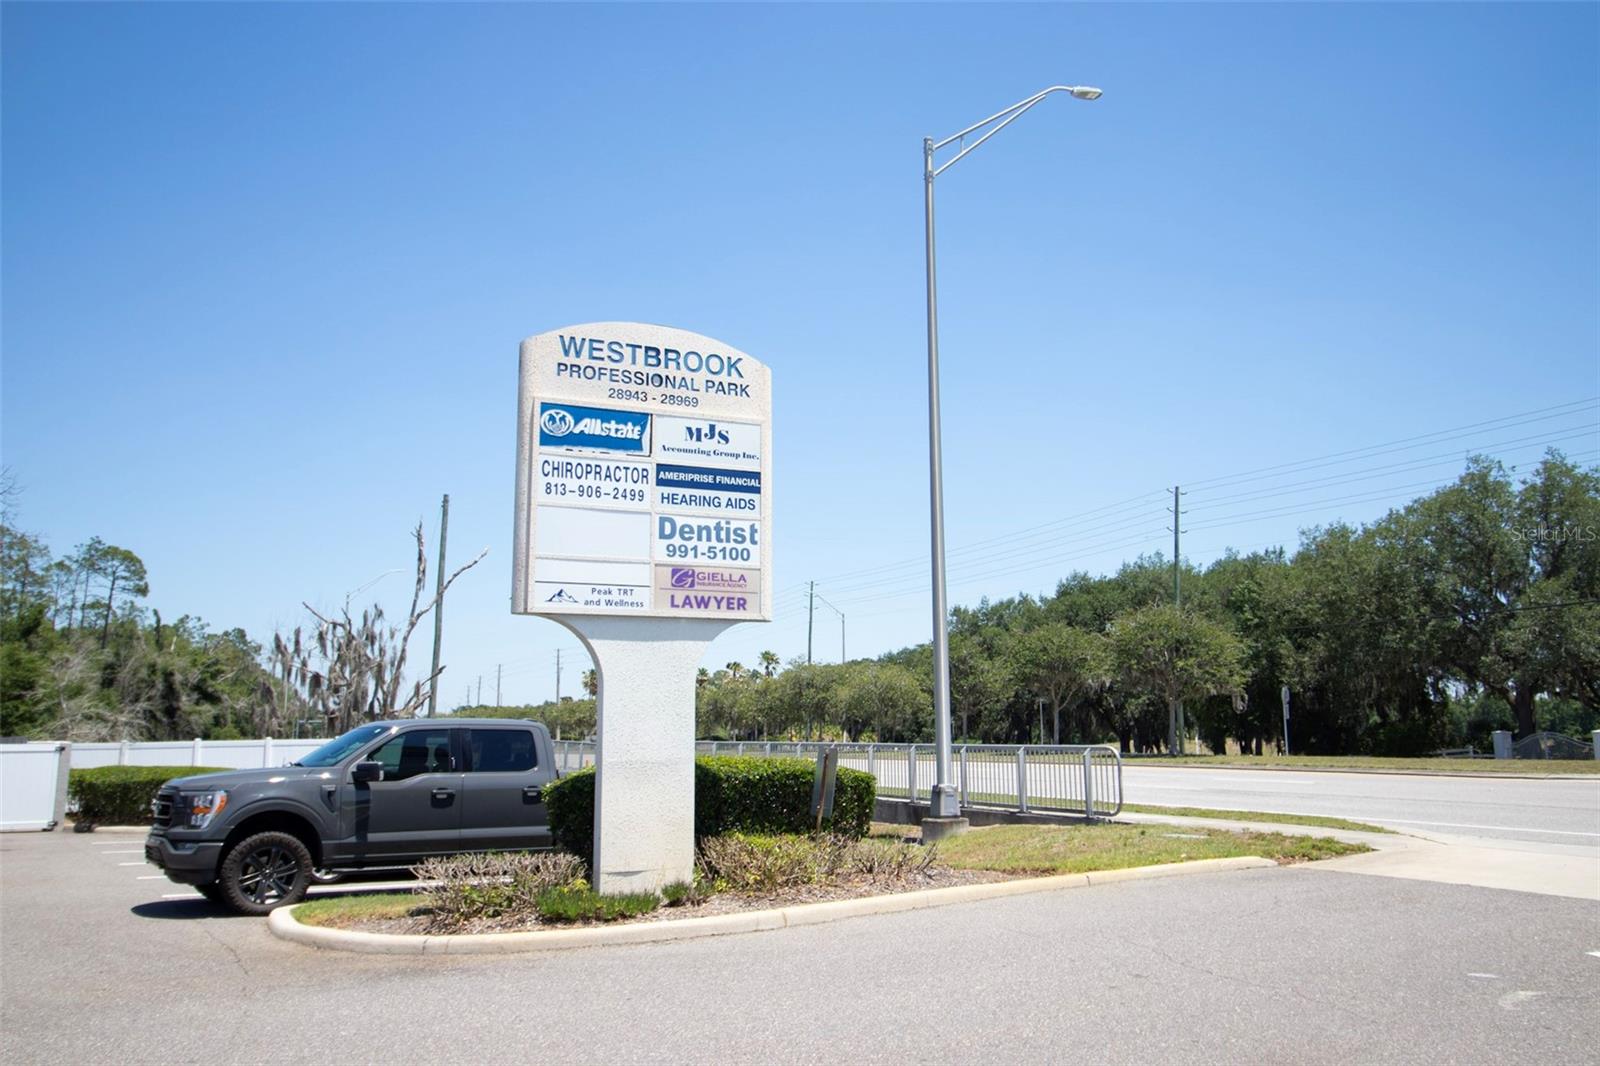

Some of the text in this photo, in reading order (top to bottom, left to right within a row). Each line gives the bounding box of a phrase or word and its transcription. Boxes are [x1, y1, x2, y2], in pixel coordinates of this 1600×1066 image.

[558, 335, 744, 378] WESTBROOK
[557, 362, 750, 398] PROFESSIONAL PARK
[608, 388, 648, 402] 28943
[660, 393, 699, 407] 28969
[572, 417, 641, 439] Allstate
[685, 423, 730, 445] MJS
[661, 444, 760, 460] Accounting Group Inc.
[542, 460, 649, 485] CHIROPRACTOR
[658, 471, 761, 487] AMERIPRISE FINANCIAL
[545, 482, 645, 502] 813-906-2499
[661, 492, 756, 510] HEARING AIDS
[658, 516, 758, 545] Dentist
[666, 543, 750, 561] 991-5100
[696, 571, 747, 583] GIELLA
[591, 587, 635, 596] Peak TRT
[604, 599, 644, 608] Wellness
[670, 594, 747, 610] LAWYER
